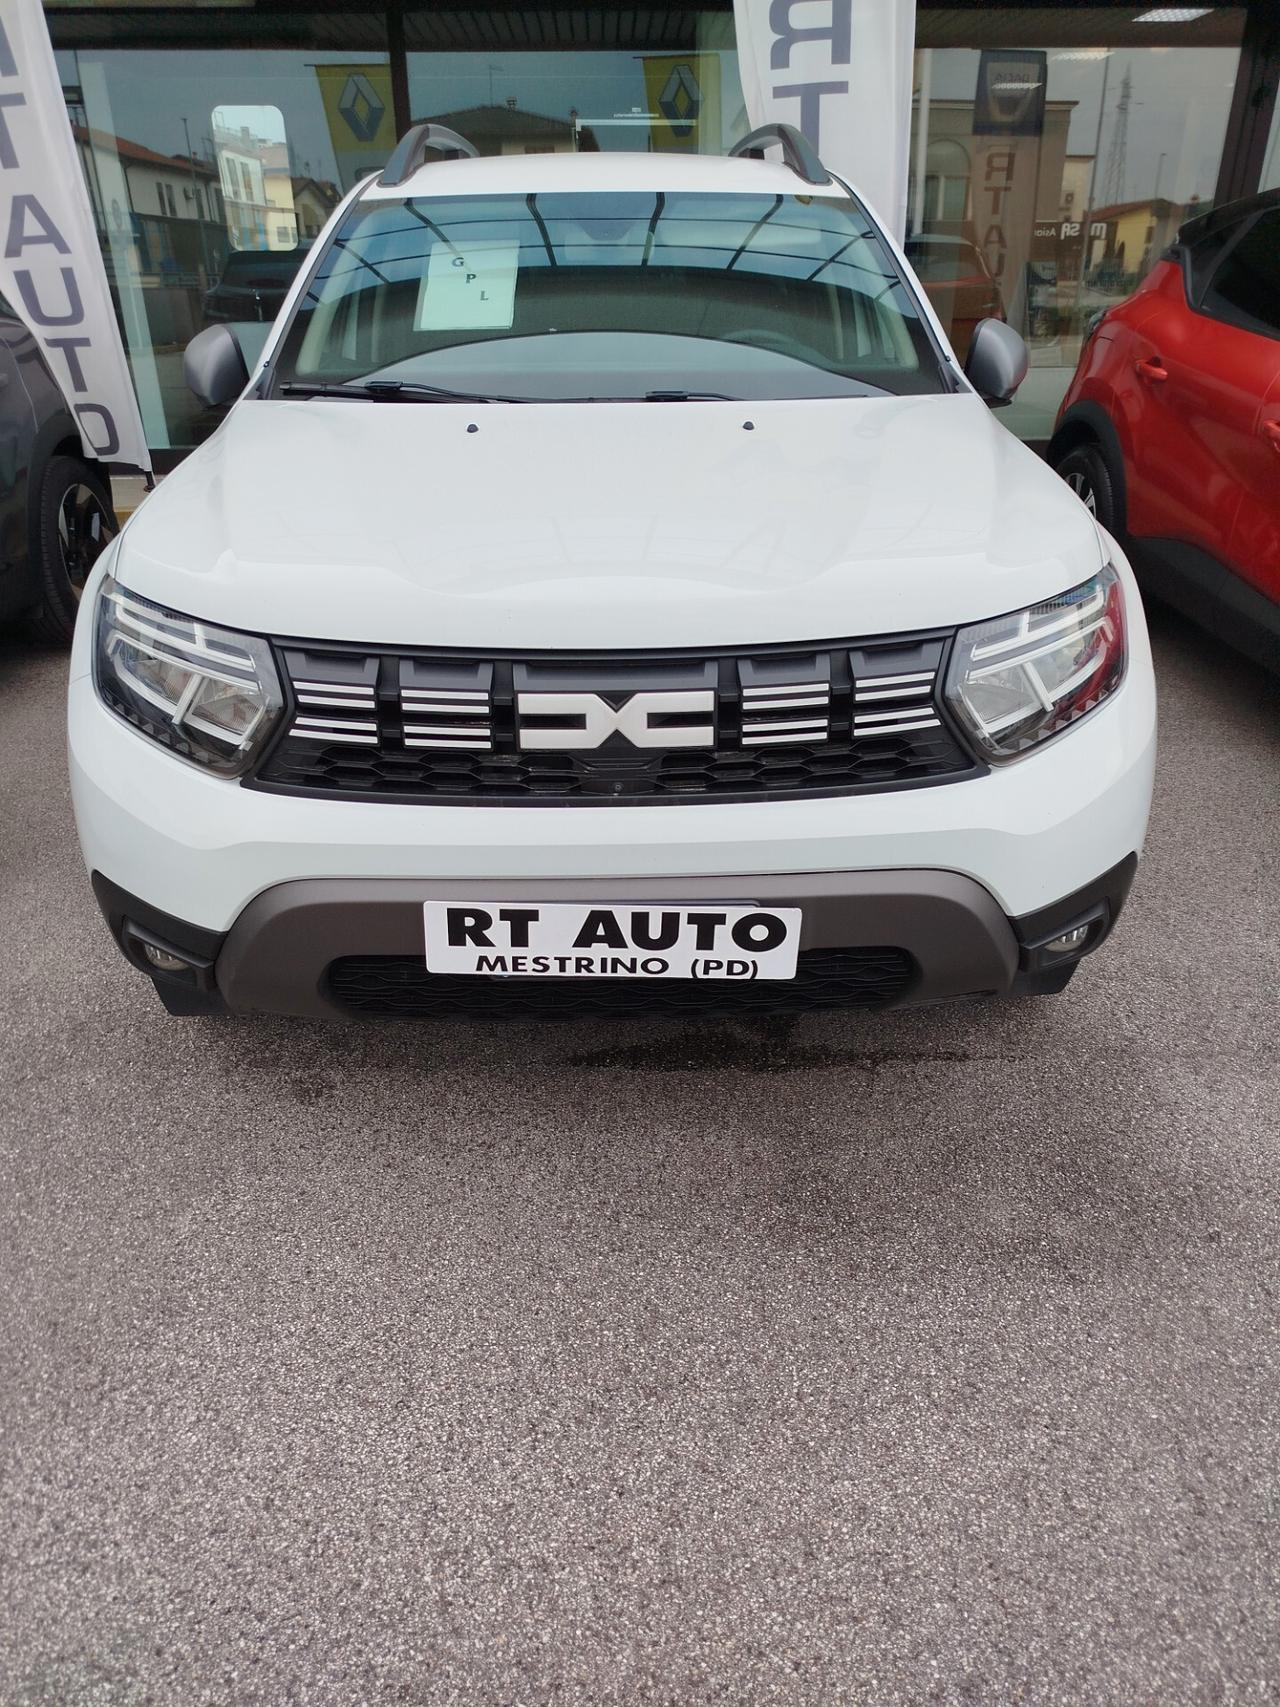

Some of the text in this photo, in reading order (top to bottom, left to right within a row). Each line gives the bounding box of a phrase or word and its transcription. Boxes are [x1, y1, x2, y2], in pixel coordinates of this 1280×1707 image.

[446, 907, 788, 953] RT AUTO
[475, 955, 759, 980] MESTRINO (PD)
